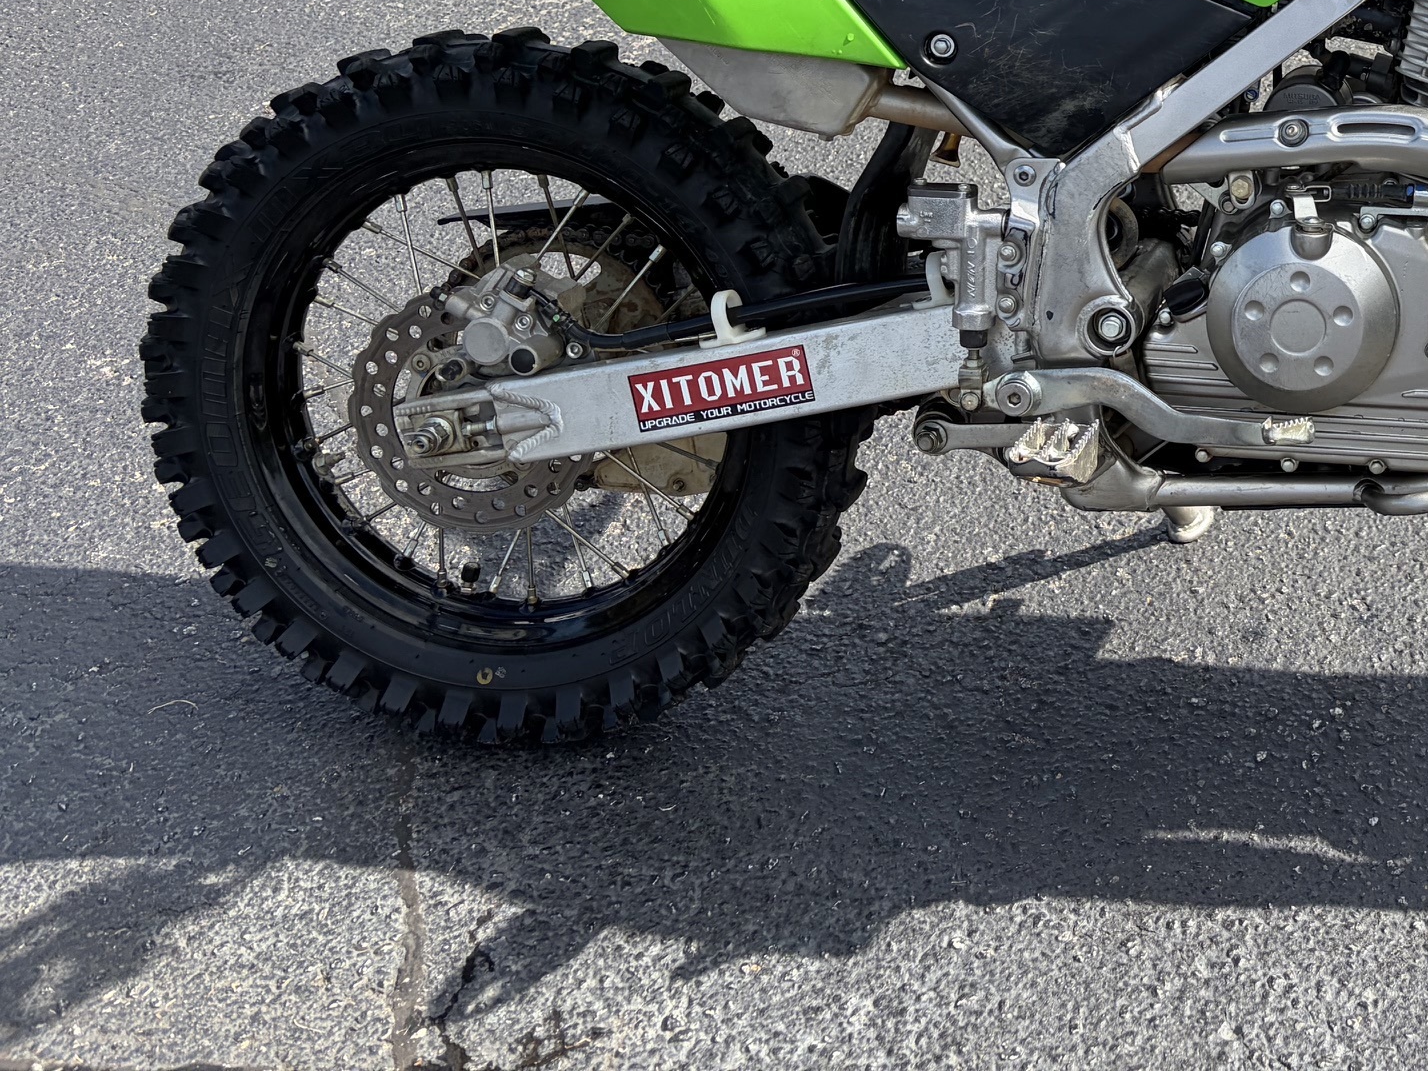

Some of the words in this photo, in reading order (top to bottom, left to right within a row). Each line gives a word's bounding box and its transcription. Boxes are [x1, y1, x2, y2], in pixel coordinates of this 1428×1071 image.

[634, 356, 805, 414] XITOMER
[640, 412, 695, 430] UPGRADE
[700, 406, 732, 420] YOUR
[737, 390, 814, 413] MOTORCYCLE
[606, 494, 762, 667] DUNLOP
